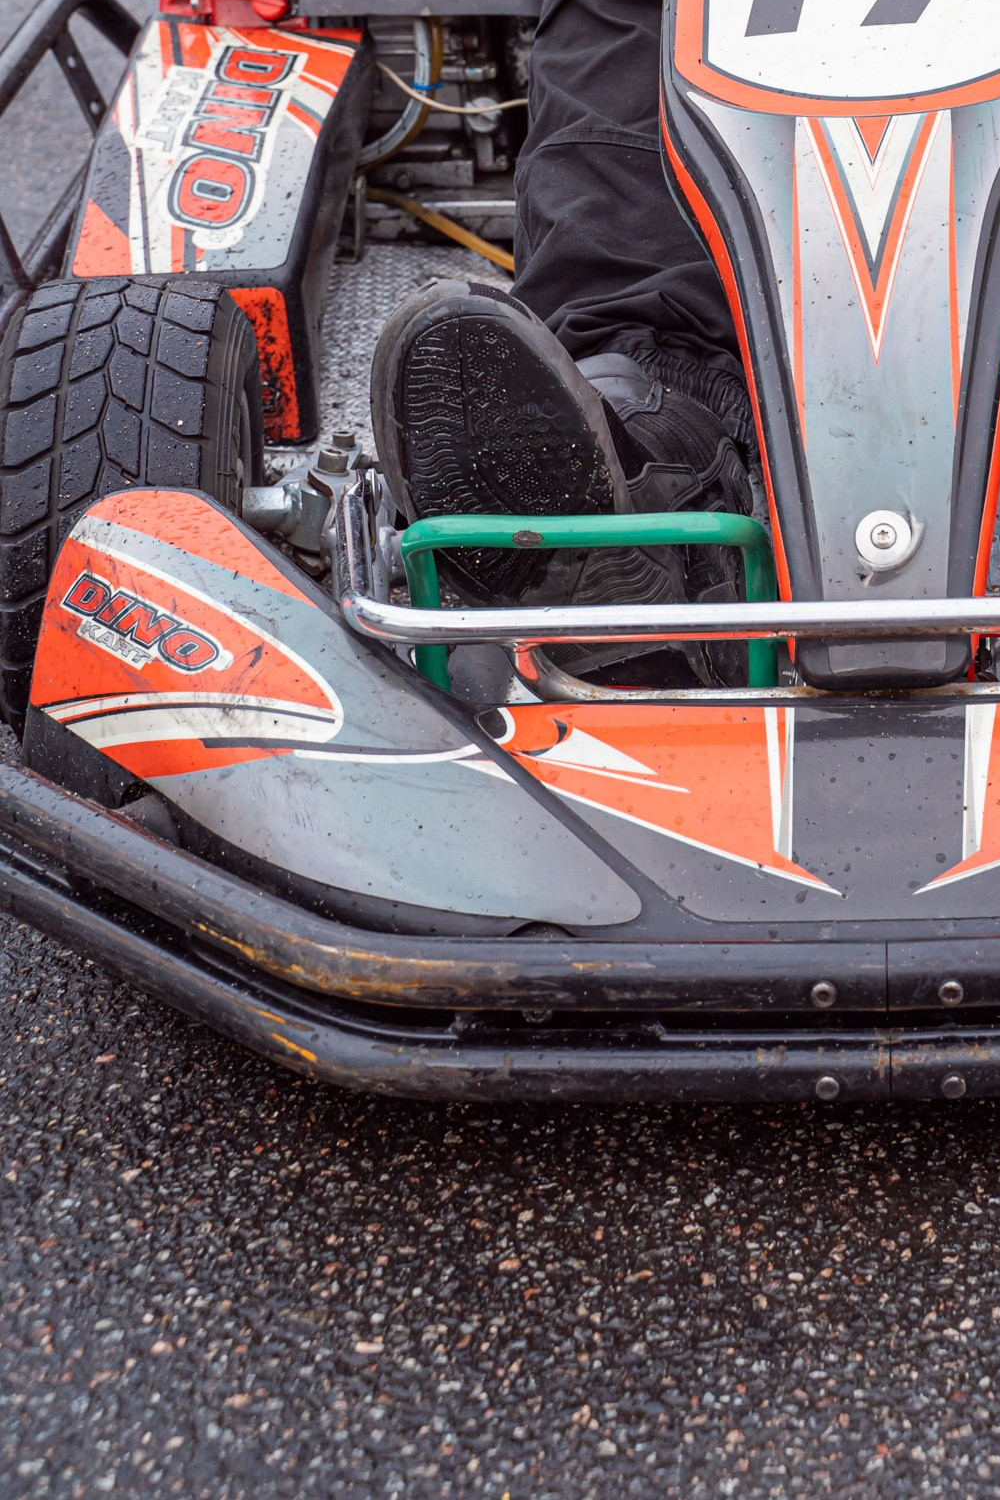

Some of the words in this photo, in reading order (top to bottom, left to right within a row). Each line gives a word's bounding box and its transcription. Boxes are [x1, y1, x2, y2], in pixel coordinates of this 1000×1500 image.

[145, 70, 205, 153] KART
[167, 45, 300, 230] DINO
[62, 573, 220, 672] DINO
[80, 620, 152, 664] KART
